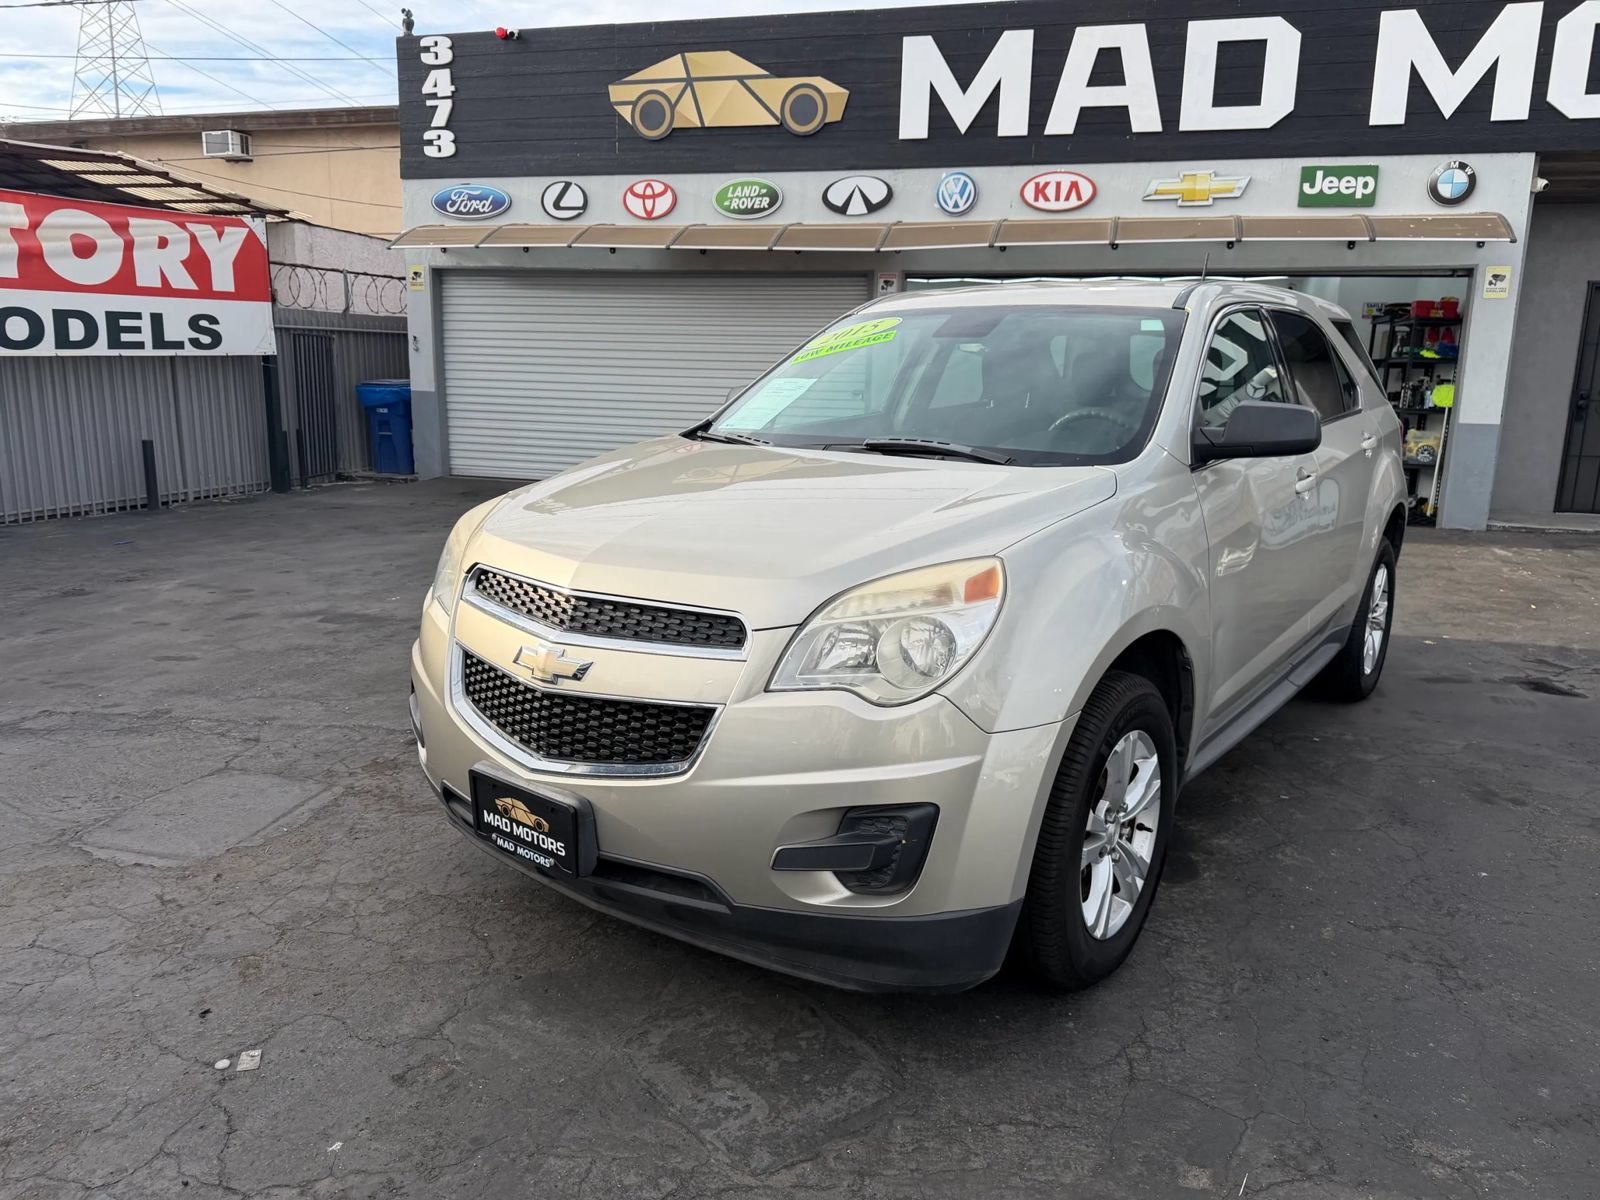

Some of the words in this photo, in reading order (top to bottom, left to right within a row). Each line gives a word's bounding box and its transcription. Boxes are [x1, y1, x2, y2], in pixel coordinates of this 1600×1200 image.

[898, 17, 1302, 141] MAD
[420, 36, 456, 159] 3473
[1435, 161, 1474, 176] BMW
[727, 185, 760, 198] LAND
[1033, 180, 1083, 202] KIA
[1302, 170, 1376, 199] Jeep
[446, 189, 494, 213] Ford
[730, 197, 770, 209] ROVER
[0, 306, 223, 351] ODELS
[826, 331, 894, 352] MILEAGE
[483, 809, 511, 833] MAD
[512, 822, 566, 857] MOTORS
[496, 837, 515, 852] MAD
[516, 846, 551, 868] MOTORS
